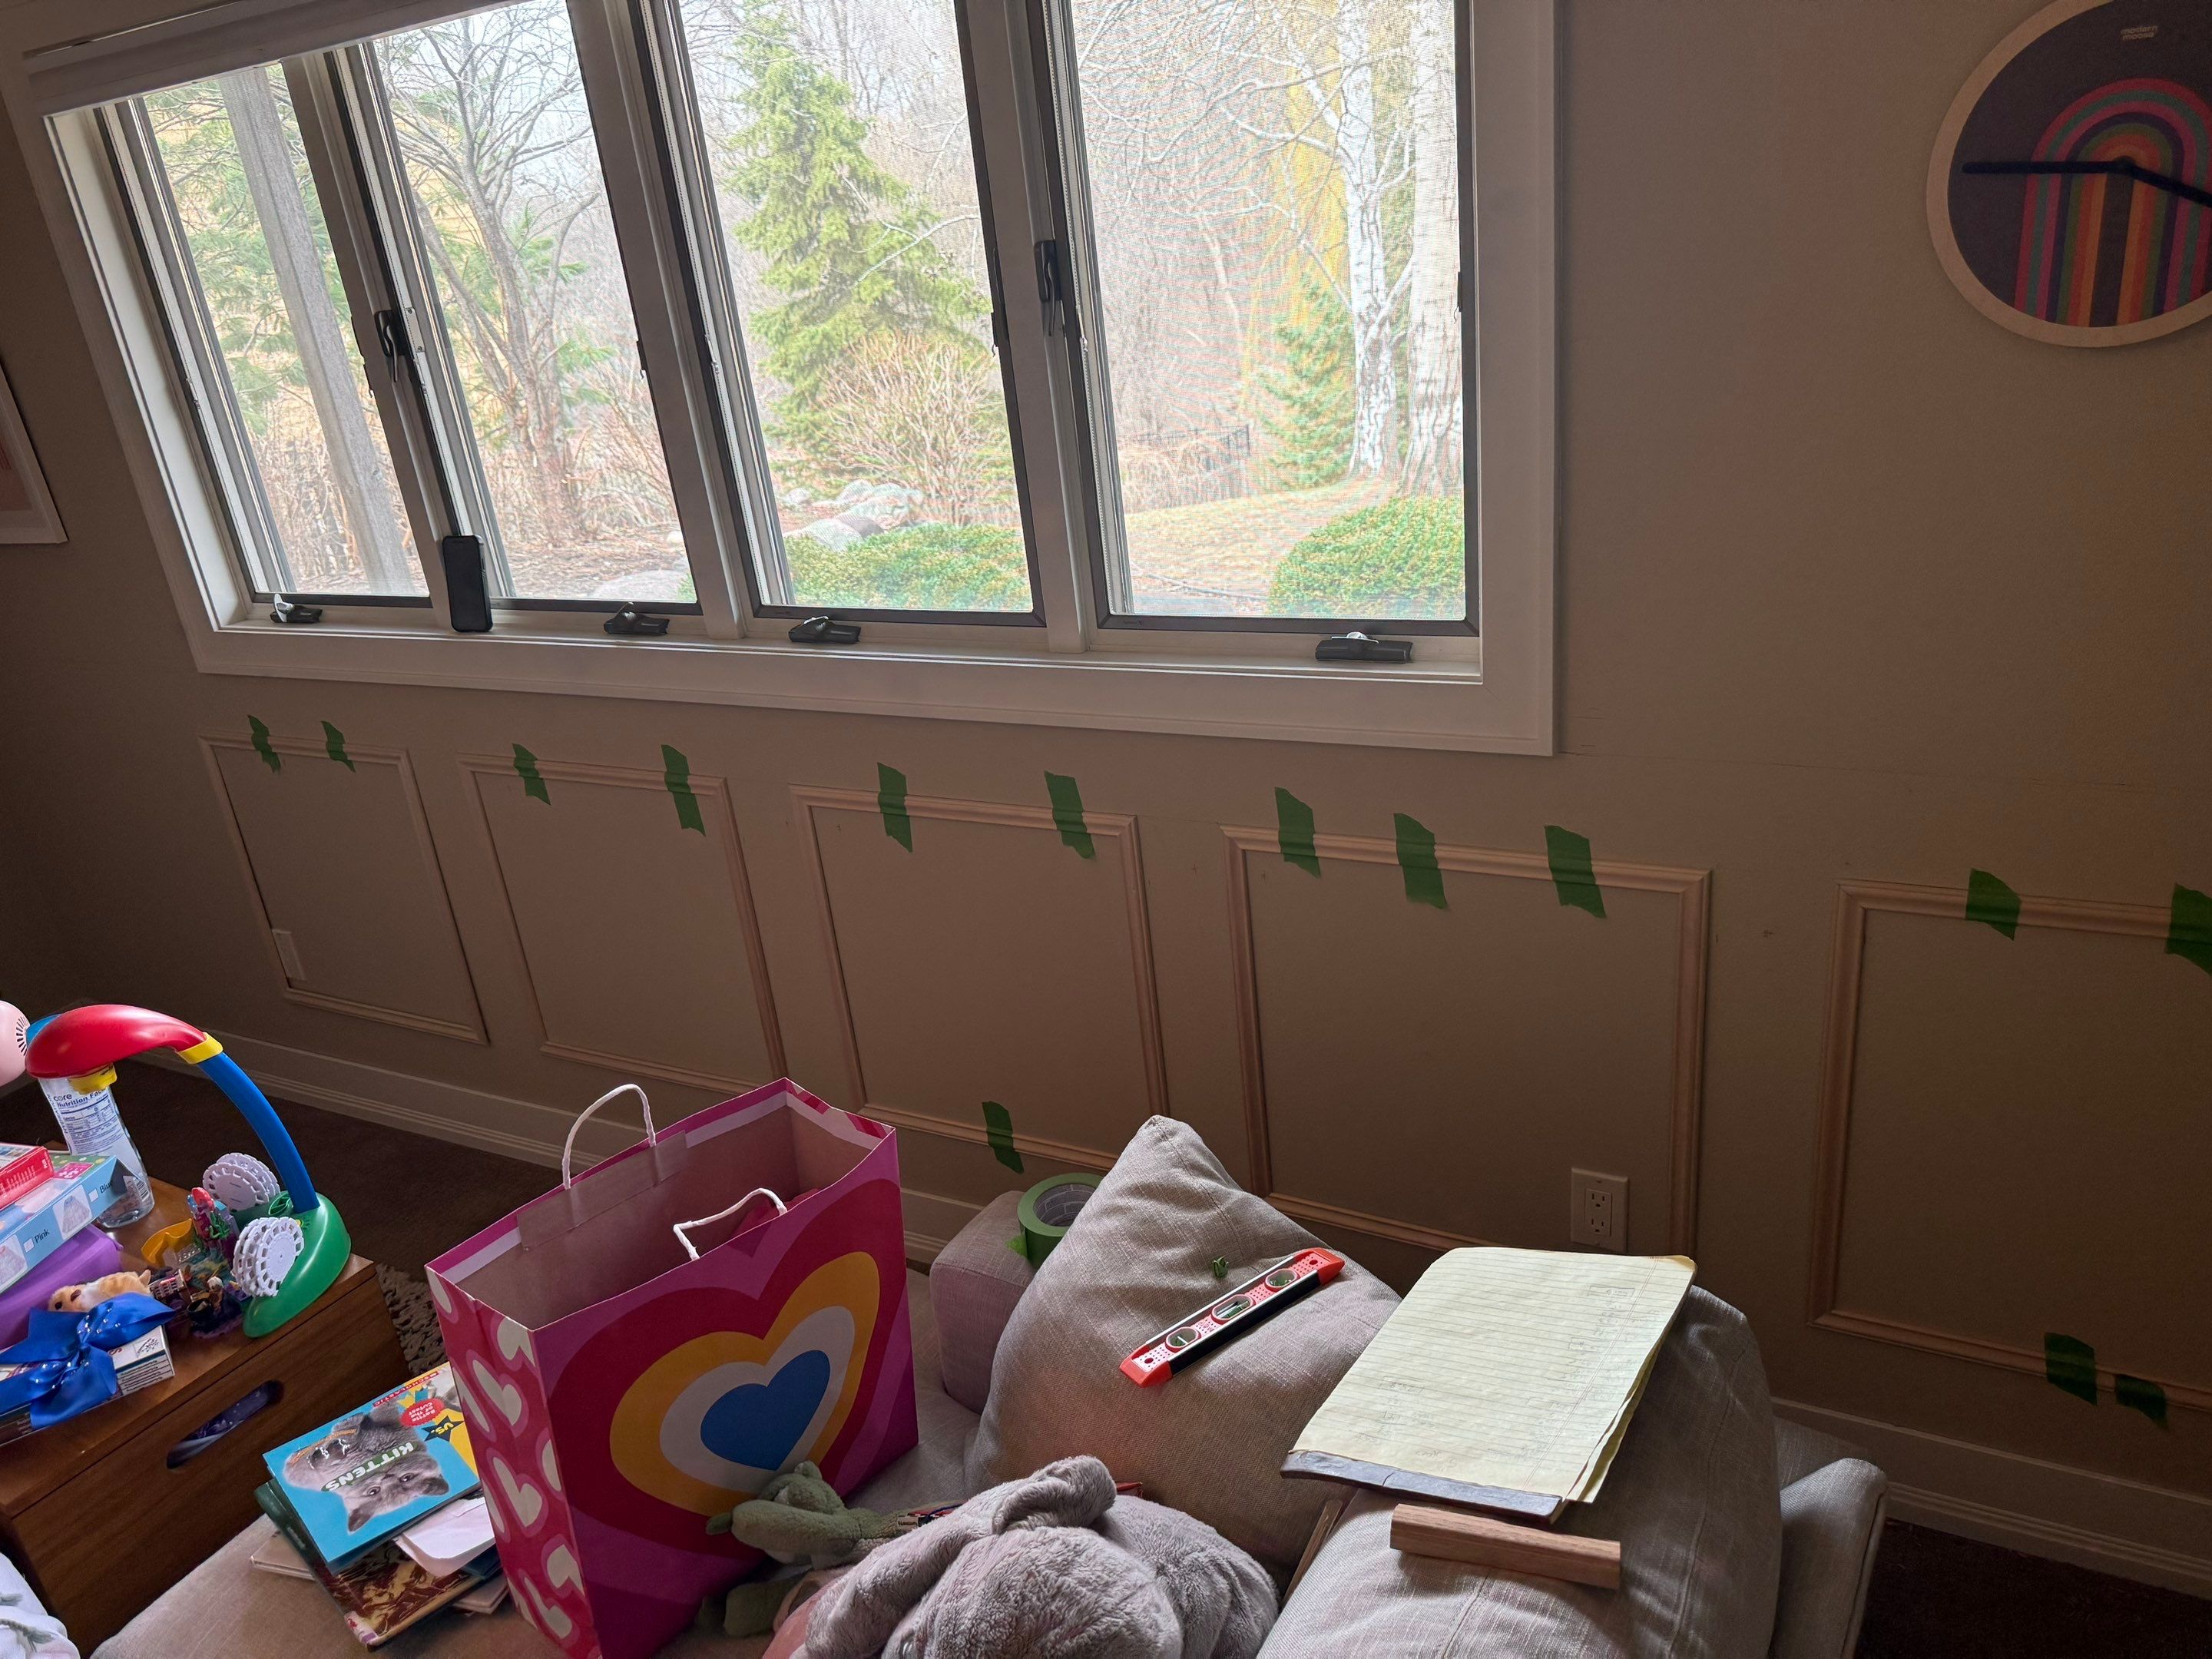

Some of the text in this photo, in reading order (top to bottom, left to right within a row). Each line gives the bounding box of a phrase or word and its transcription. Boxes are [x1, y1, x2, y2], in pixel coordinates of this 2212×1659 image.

[57, 1097, 88, 1108] Nutrition
[35, 1228, 50, 1243] Pink
[373, 1376, 429, 1406] SCHOLASTIC
[325, 1442, 414, 1492] KITTENS
